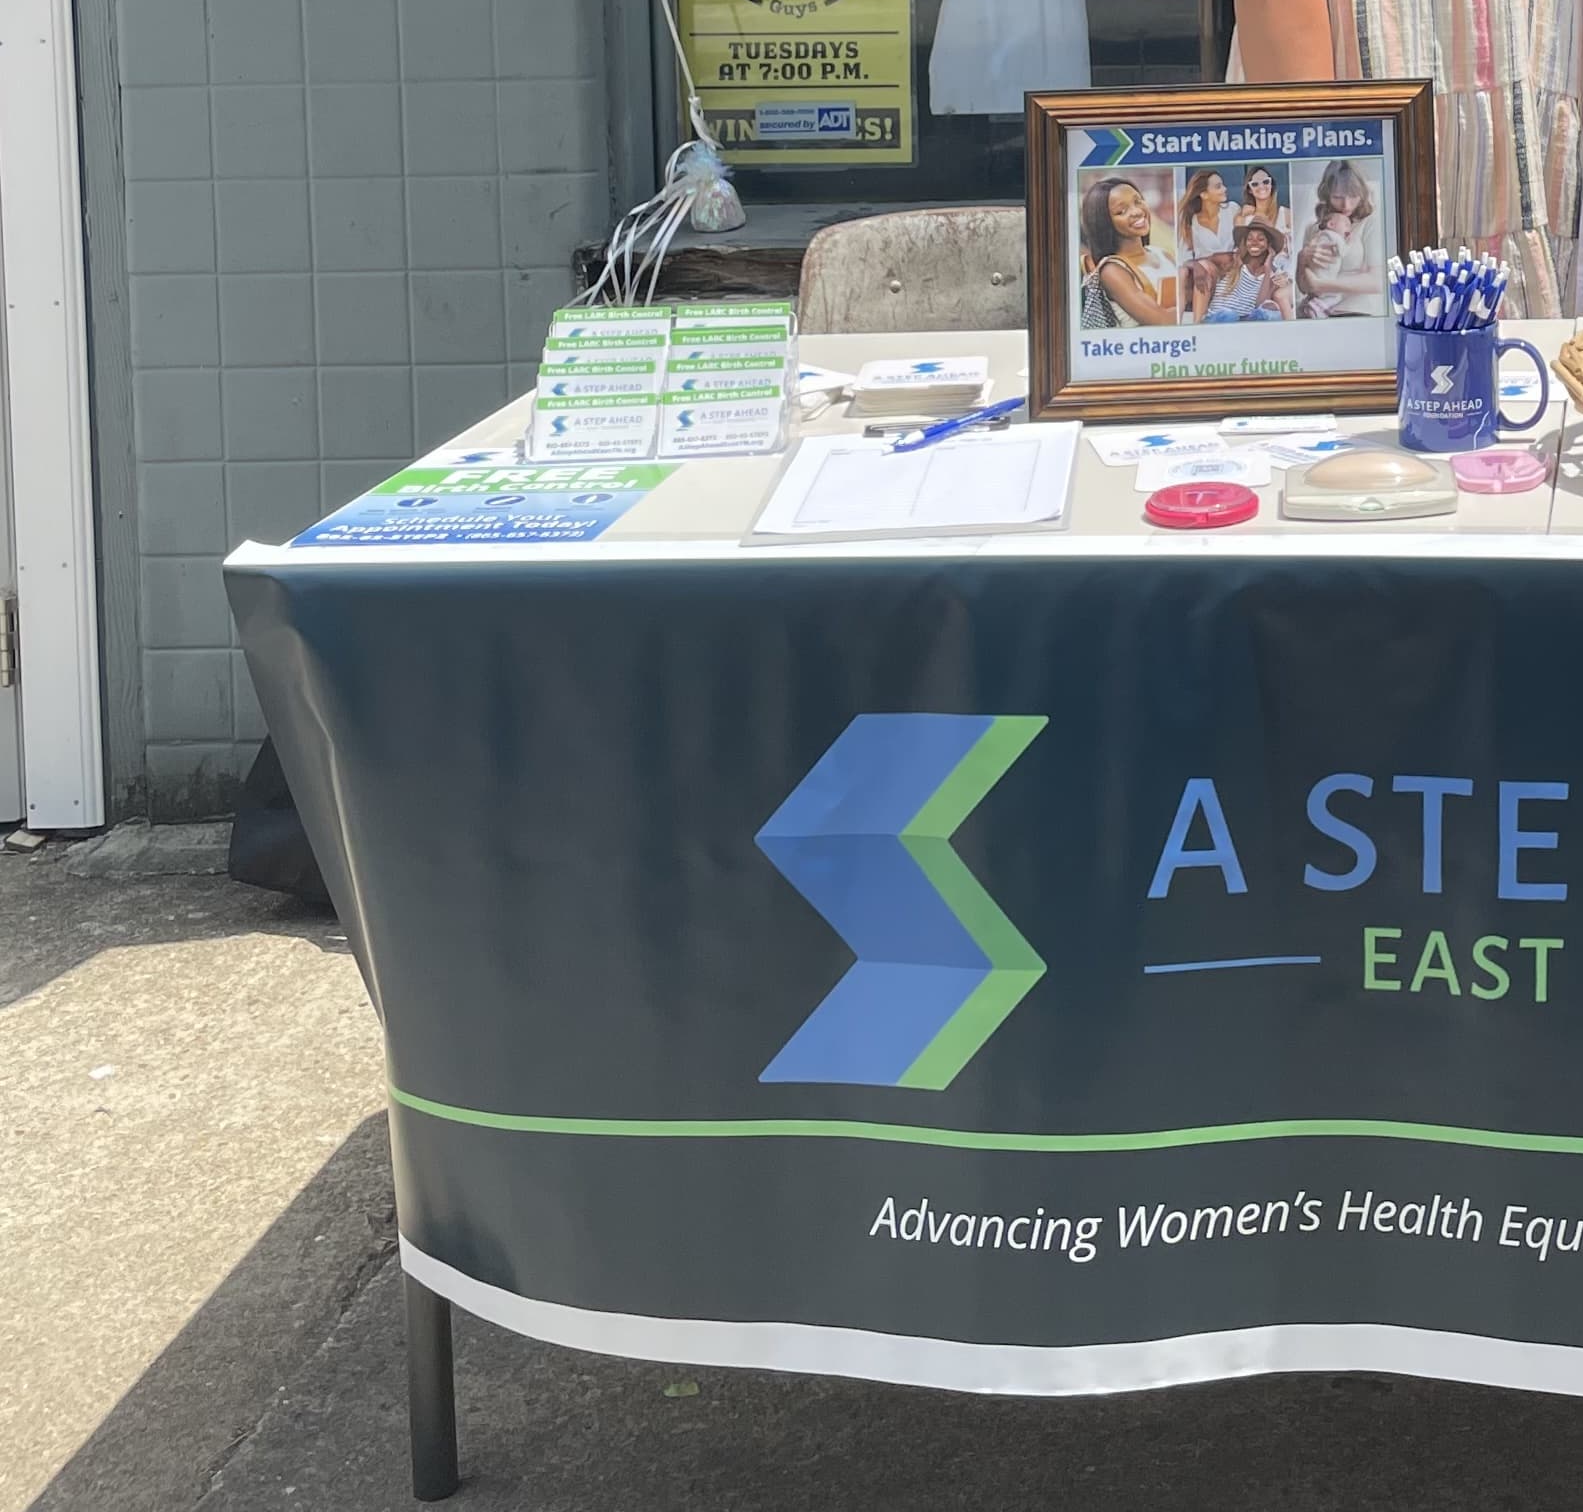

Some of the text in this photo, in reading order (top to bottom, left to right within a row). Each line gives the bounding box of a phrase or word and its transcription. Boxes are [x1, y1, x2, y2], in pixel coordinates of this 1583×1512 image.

[769, 0, 818, 18] Guys
[729, 41, 859, 60] TUESDAYS
[718, 62, 869, 81] AT 7:00 P.M.
[803, 120, 816, 129] by
[820, 112, 850, 128] ADT
[1141, 126, 1373, 154] Start Making Plans.
[1081, 336, 1198, 358] Take charge!
[1150, 357, 1304, 379] Plan your future.
[1407, 399, 1483, 411] A STEP AHEAD
[440, 466, 628, 484] FREE
[329, 519, 598, 533] Appointment Today!
[384, 514, 498, 525] Schedule
[1148, 779, 1248, 898] A
[1363, 928, 1553, 1004] EAST
[870, 1196, 1102, 1262] Advancing
[1118, 1191, 1323, 1250] Women's
[1337, 1190, 1483, 1242] Health
